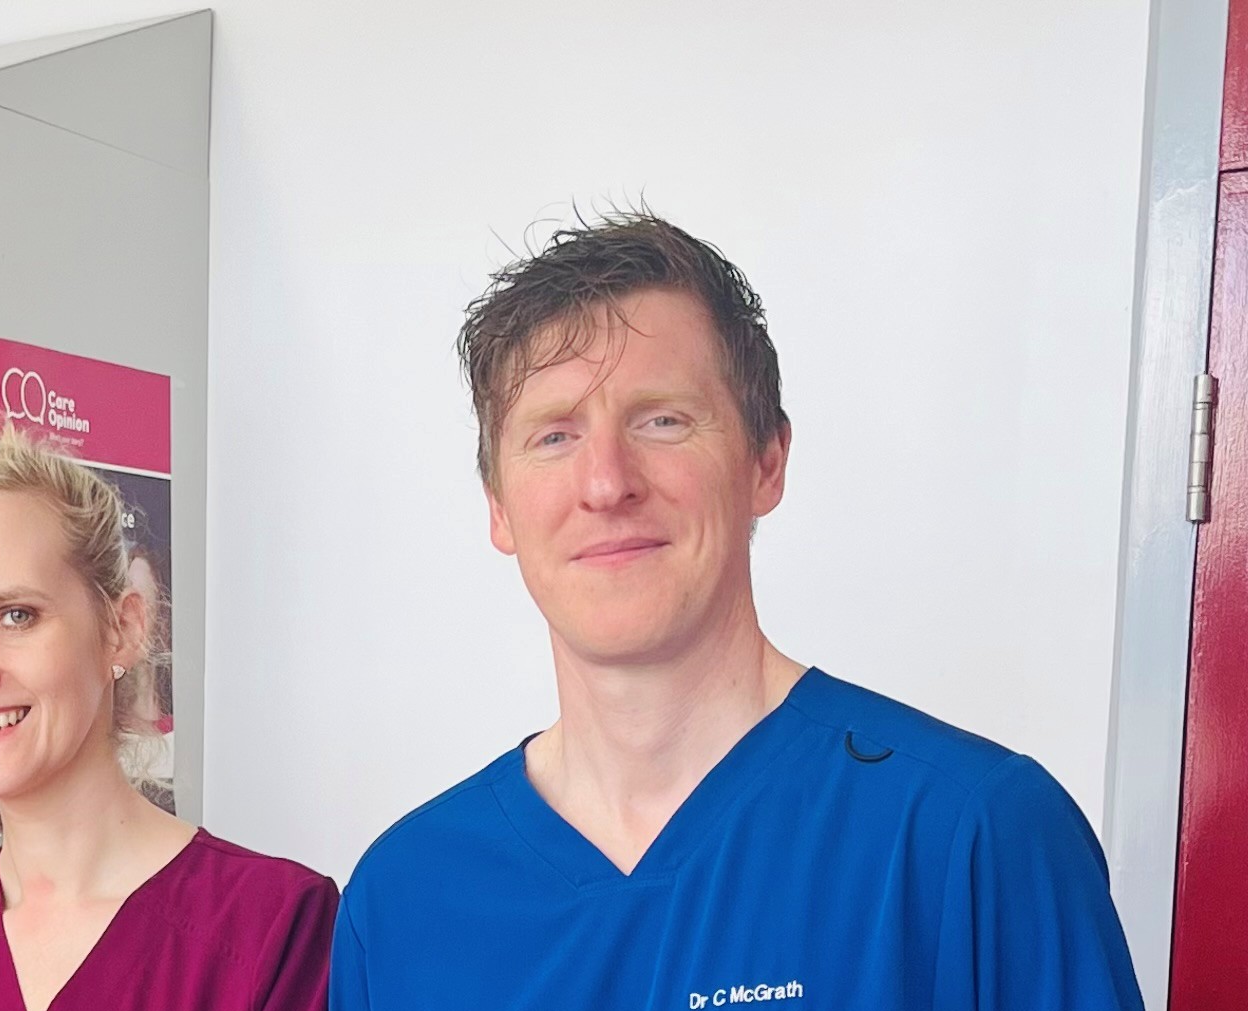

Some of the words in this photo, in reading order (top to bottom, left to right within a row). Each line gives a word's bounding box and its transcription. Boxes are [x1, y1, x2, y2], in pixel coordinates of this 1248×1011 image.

[48, 389, 75, 413] Care
[48, 408, 90, 433] Opinion
[689, 992, 709, 1010] Dr
[713, 989, 727, 1006] C
[729, 980, 803, 1004] McGrath
